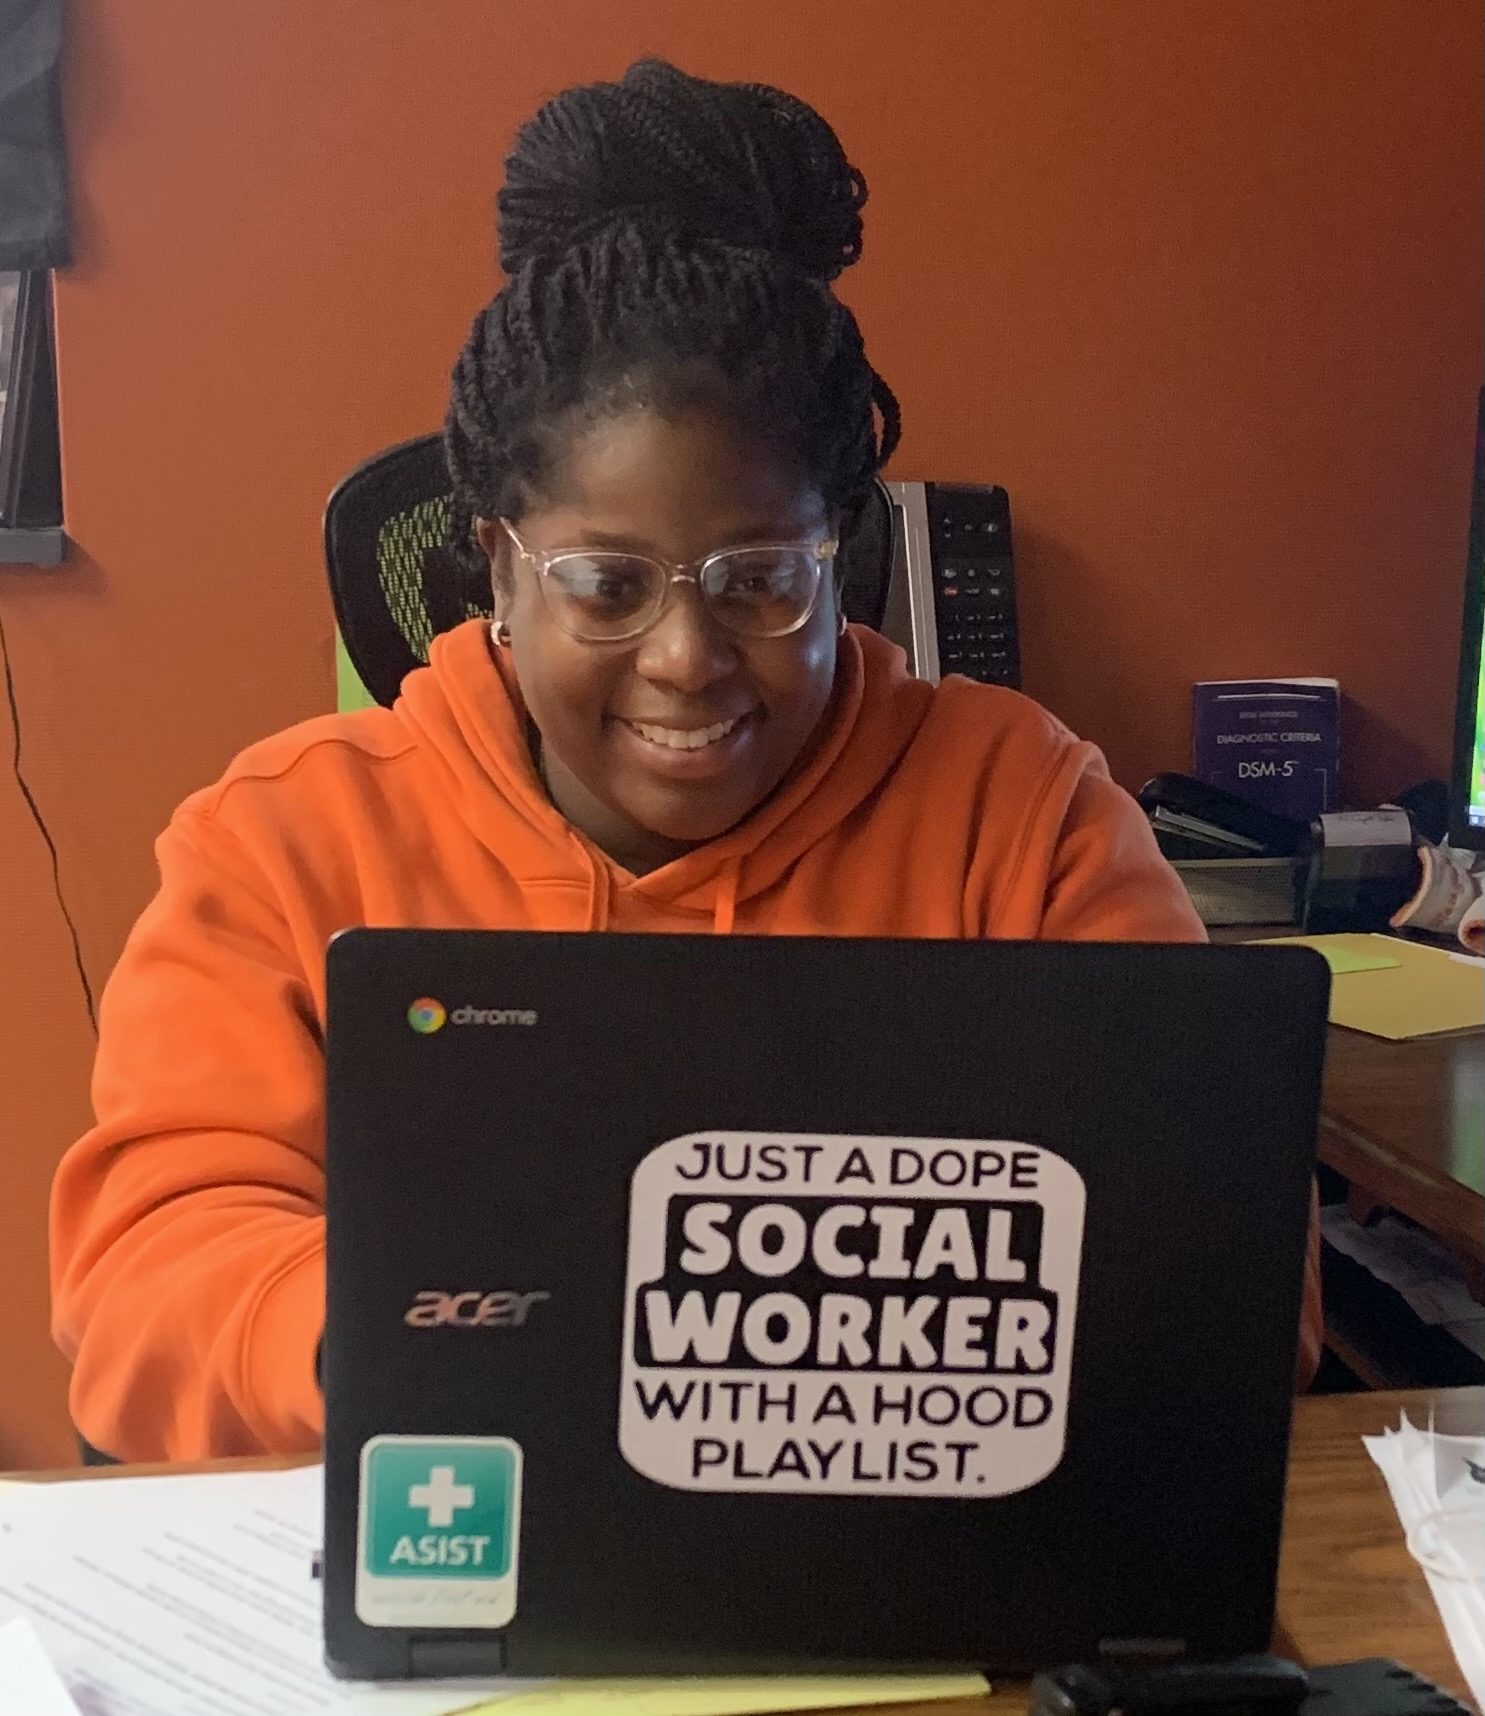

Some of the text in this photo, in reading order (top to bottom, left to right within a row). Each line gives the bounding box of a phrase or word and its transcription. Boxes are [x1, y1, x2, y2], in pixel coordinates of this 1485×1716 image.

[451, 1005, 539, 1027] chrome
[675, 1143, 1041, 1188] JUST A DOPE
[680, 1202, 1027, 1283] SOCIAL
[403, 1290, 551, 1328] acer
[644, 1290, 1052, 1370] WORKER
[633, 1380, 1054, 1429] WITH A HOOD
[691, 1438, 987, 1485] PLAYLIST.
[389, 1534, 491, 1566] ASIST
